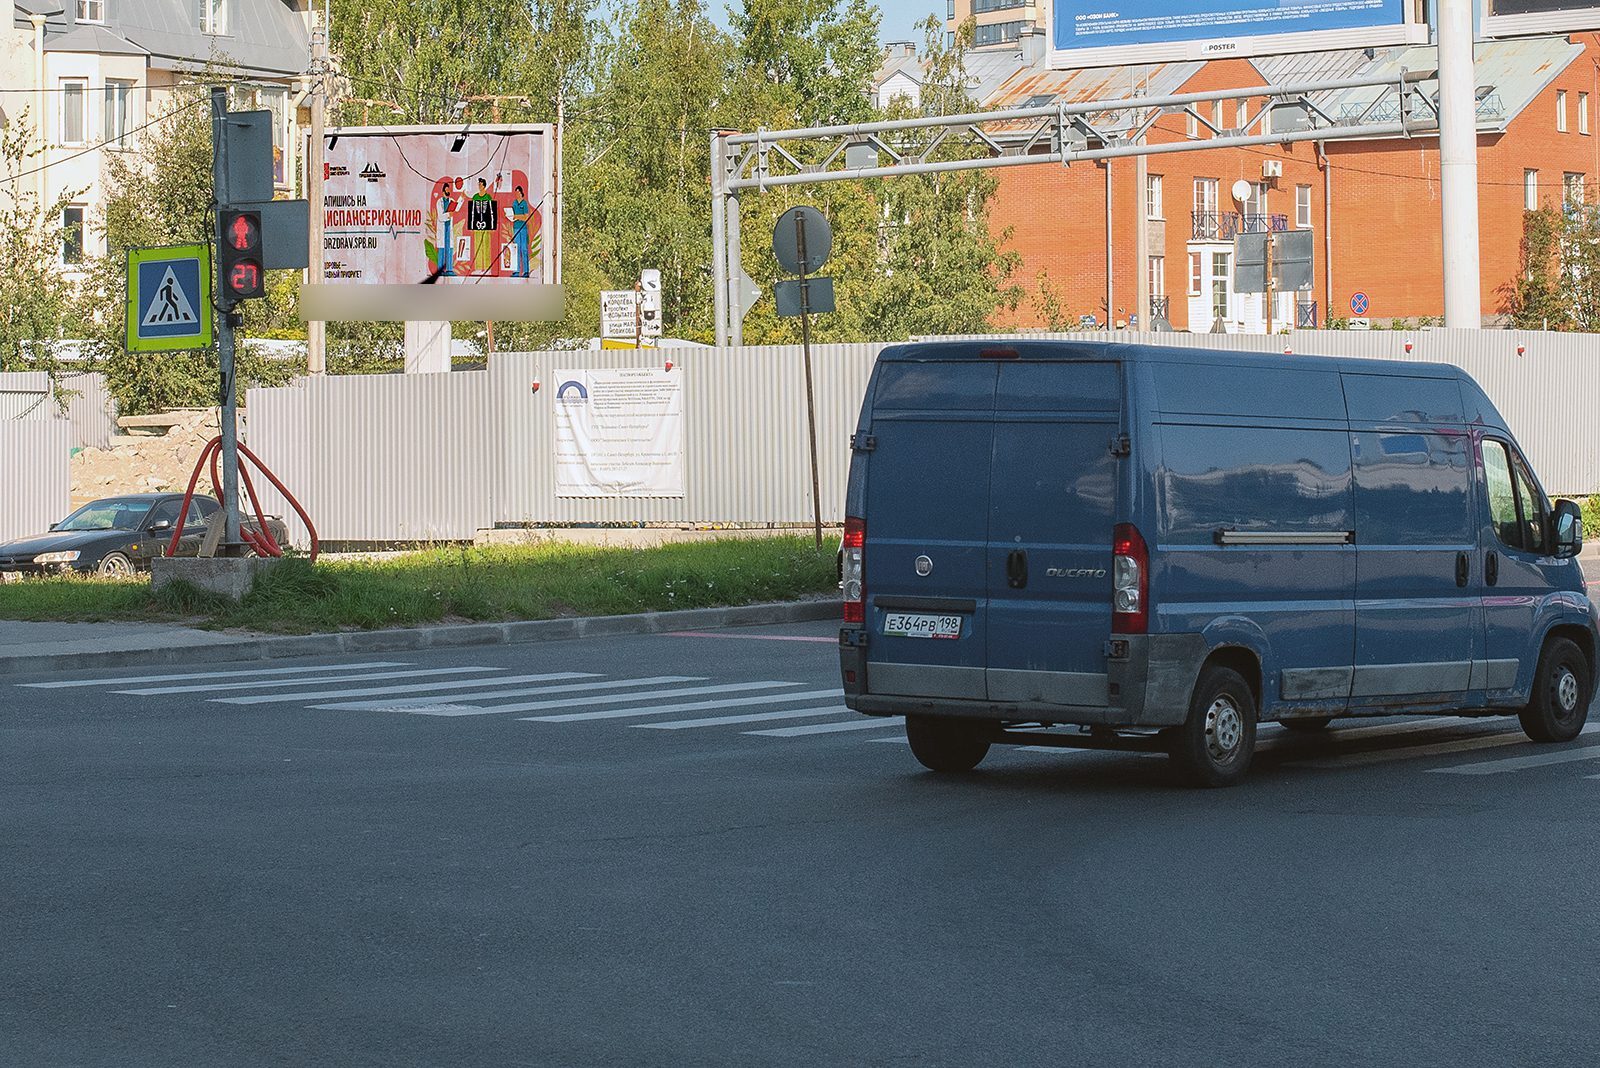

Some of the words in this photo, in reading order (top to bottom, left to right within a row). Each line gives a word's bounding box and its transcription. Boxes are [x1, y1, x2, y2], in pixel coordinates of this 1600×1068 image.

[1208, 43, 1236, 51] POSTER
[324, 195, 355, 207] АПИШИСЬ
[356, 195, 367, 207] НА
[323, 209, 421, 228] ИСПАНСЕРИЗАЦИЮ
[323, 237, 377, 249] ORZDRAV.SPB.RU
[324, 261, 341, 270] ОРОВЬЕ
[232, 263, 257, 288] 27
[324, 270, 340, 278] АВНЫЙ
[1046, 567, 1107, 578] DUCATO
[939, 617, 958, 629] 198
